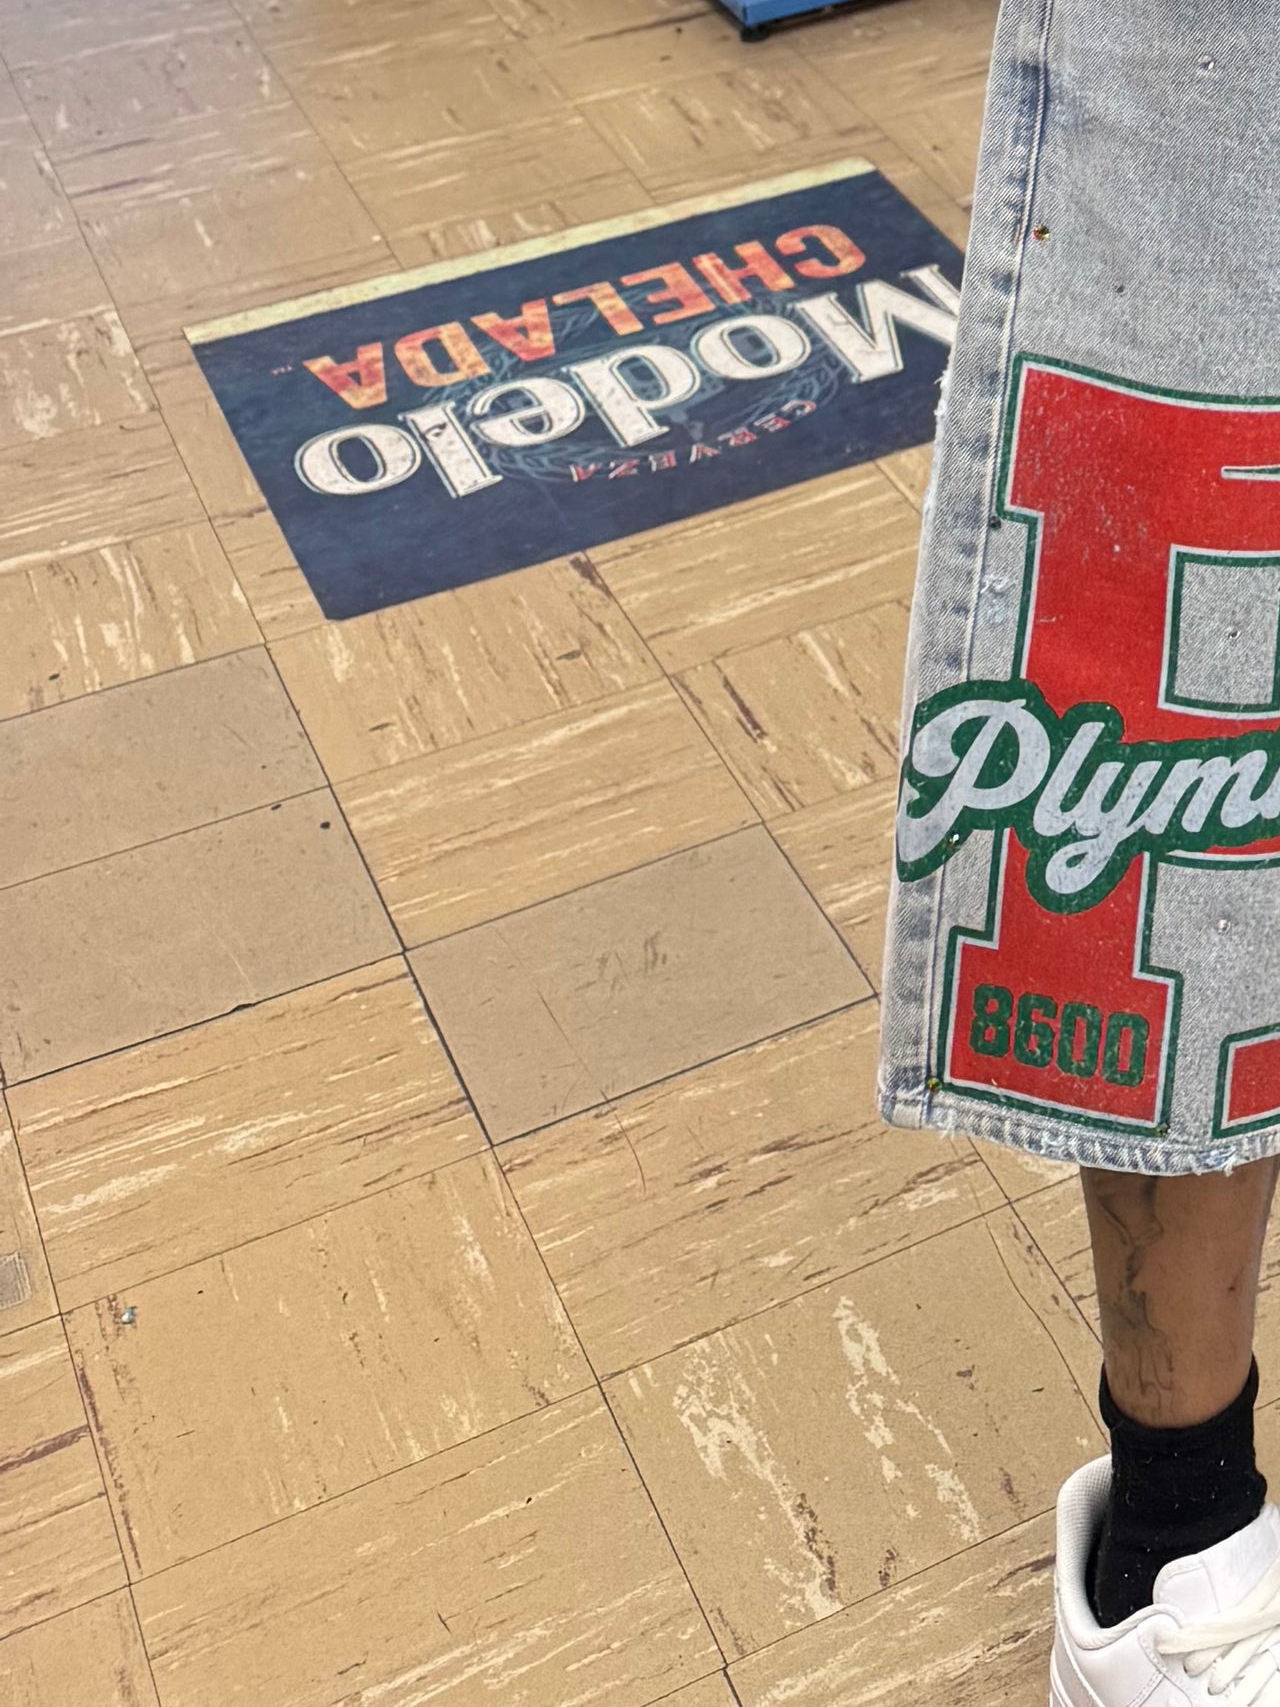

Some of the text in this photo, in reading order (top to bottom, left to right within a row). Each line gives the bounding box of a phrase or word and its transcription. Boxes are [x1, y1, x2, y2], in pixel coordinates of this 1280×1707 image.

[293, 263, 962, 500] Modelo
[302, 224, 867, 409] CHELADA
[570, 399, 817, 483] CERVEZA
[969, 983, 1151, 1088] 8600
